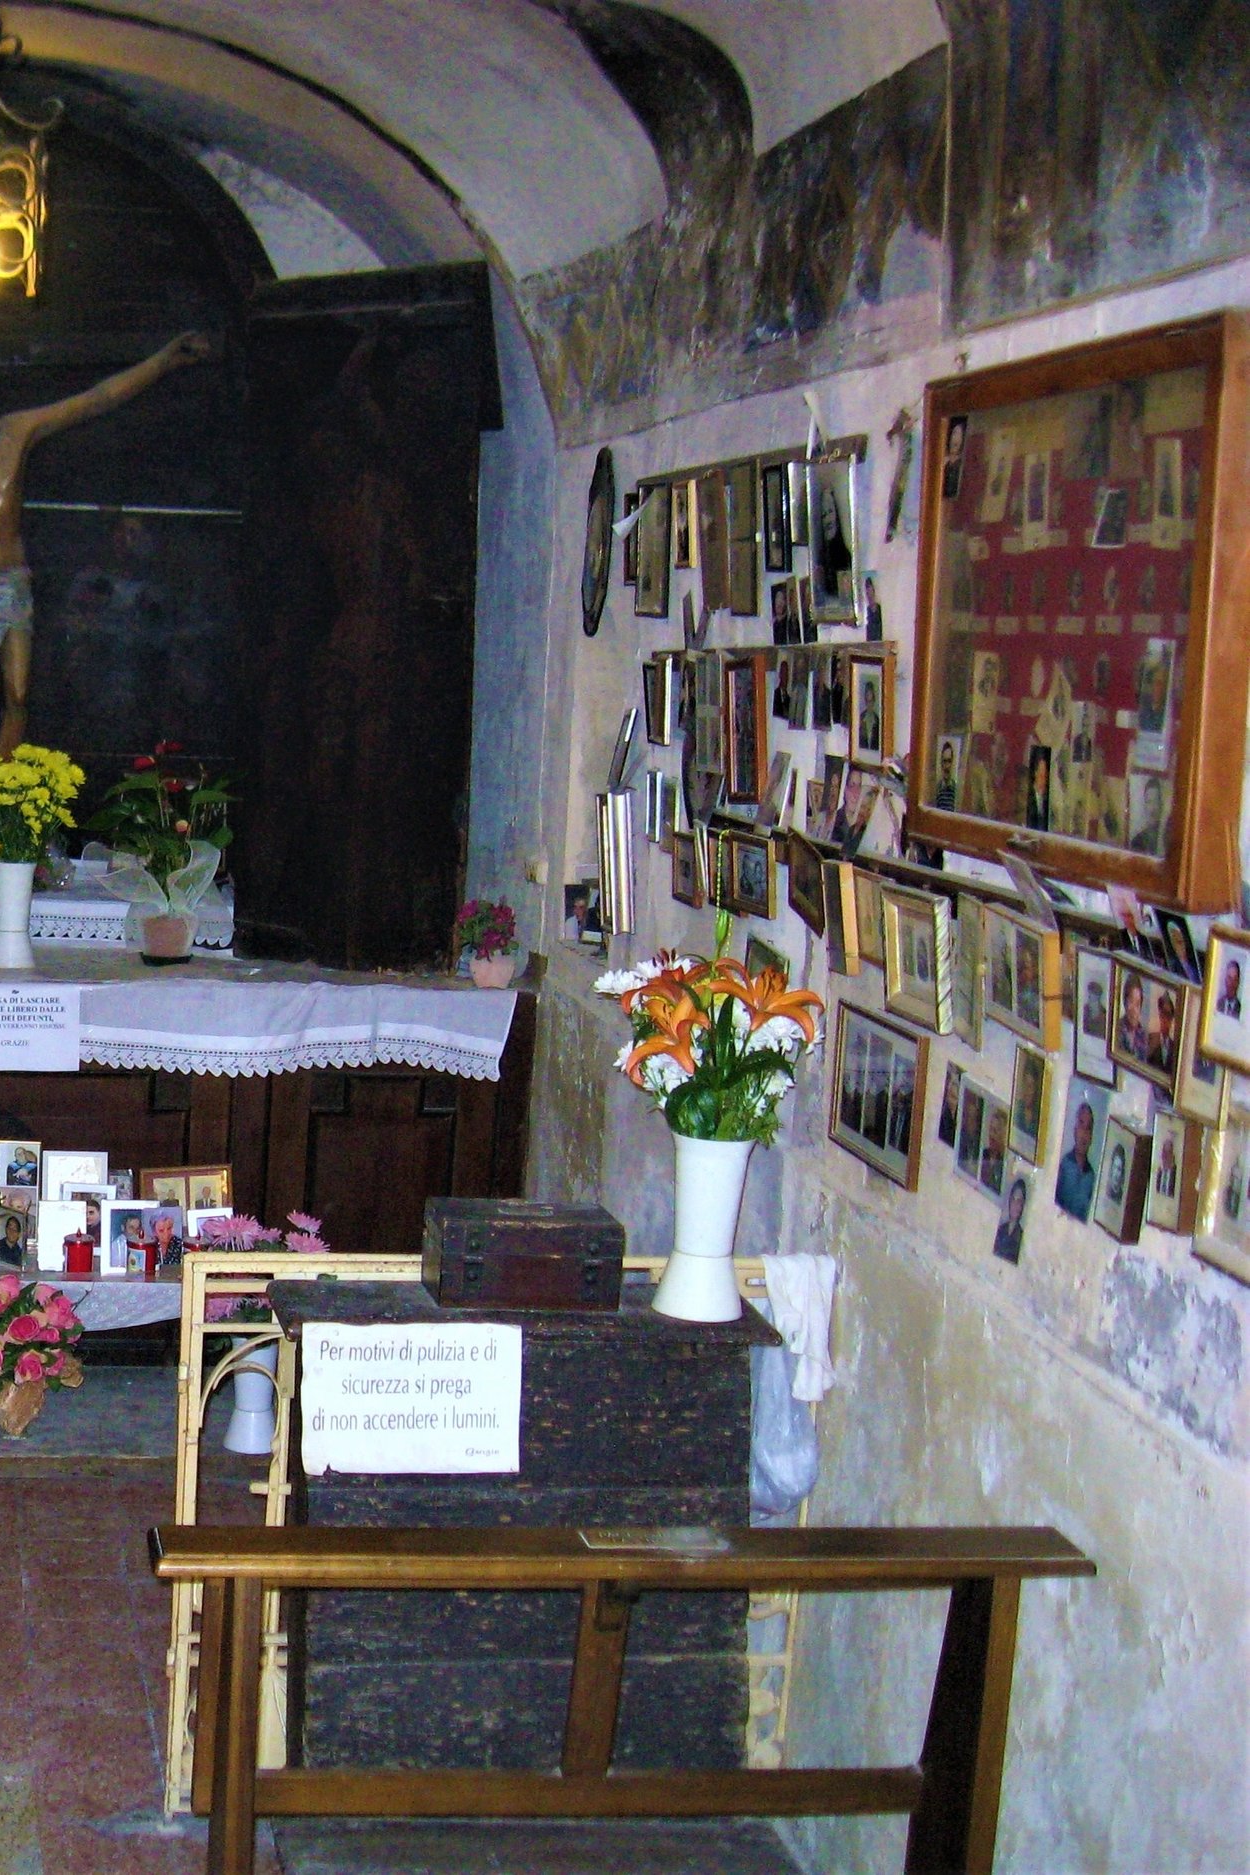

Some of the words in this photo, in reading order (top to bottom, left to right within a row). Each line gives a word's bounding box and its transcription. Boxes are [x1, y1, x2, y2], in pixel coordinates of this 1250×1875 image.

[319, 1340, 345, 1361] Per
[348, 1340, 395, 1362] motivi
[399, 1338, 413, 1362] di
[417, 1338, 465, 1366] pulizia
[470, 1345, 480, 1362] e
[483, 1337, 497, 1361] di
[341, 1373, 410, 1395] sicurezza
[414, 1373, 426, 1394] si
[430, 1378, 472, 1400] prega
[312, 1407, 325, 1431] di
[330, 1414, 358, 1431] non
[363, 1405, 439, 1430] accendere
[443, 1406, 448, 1429] i
[452, 1404, 500, 1430] lumini.
